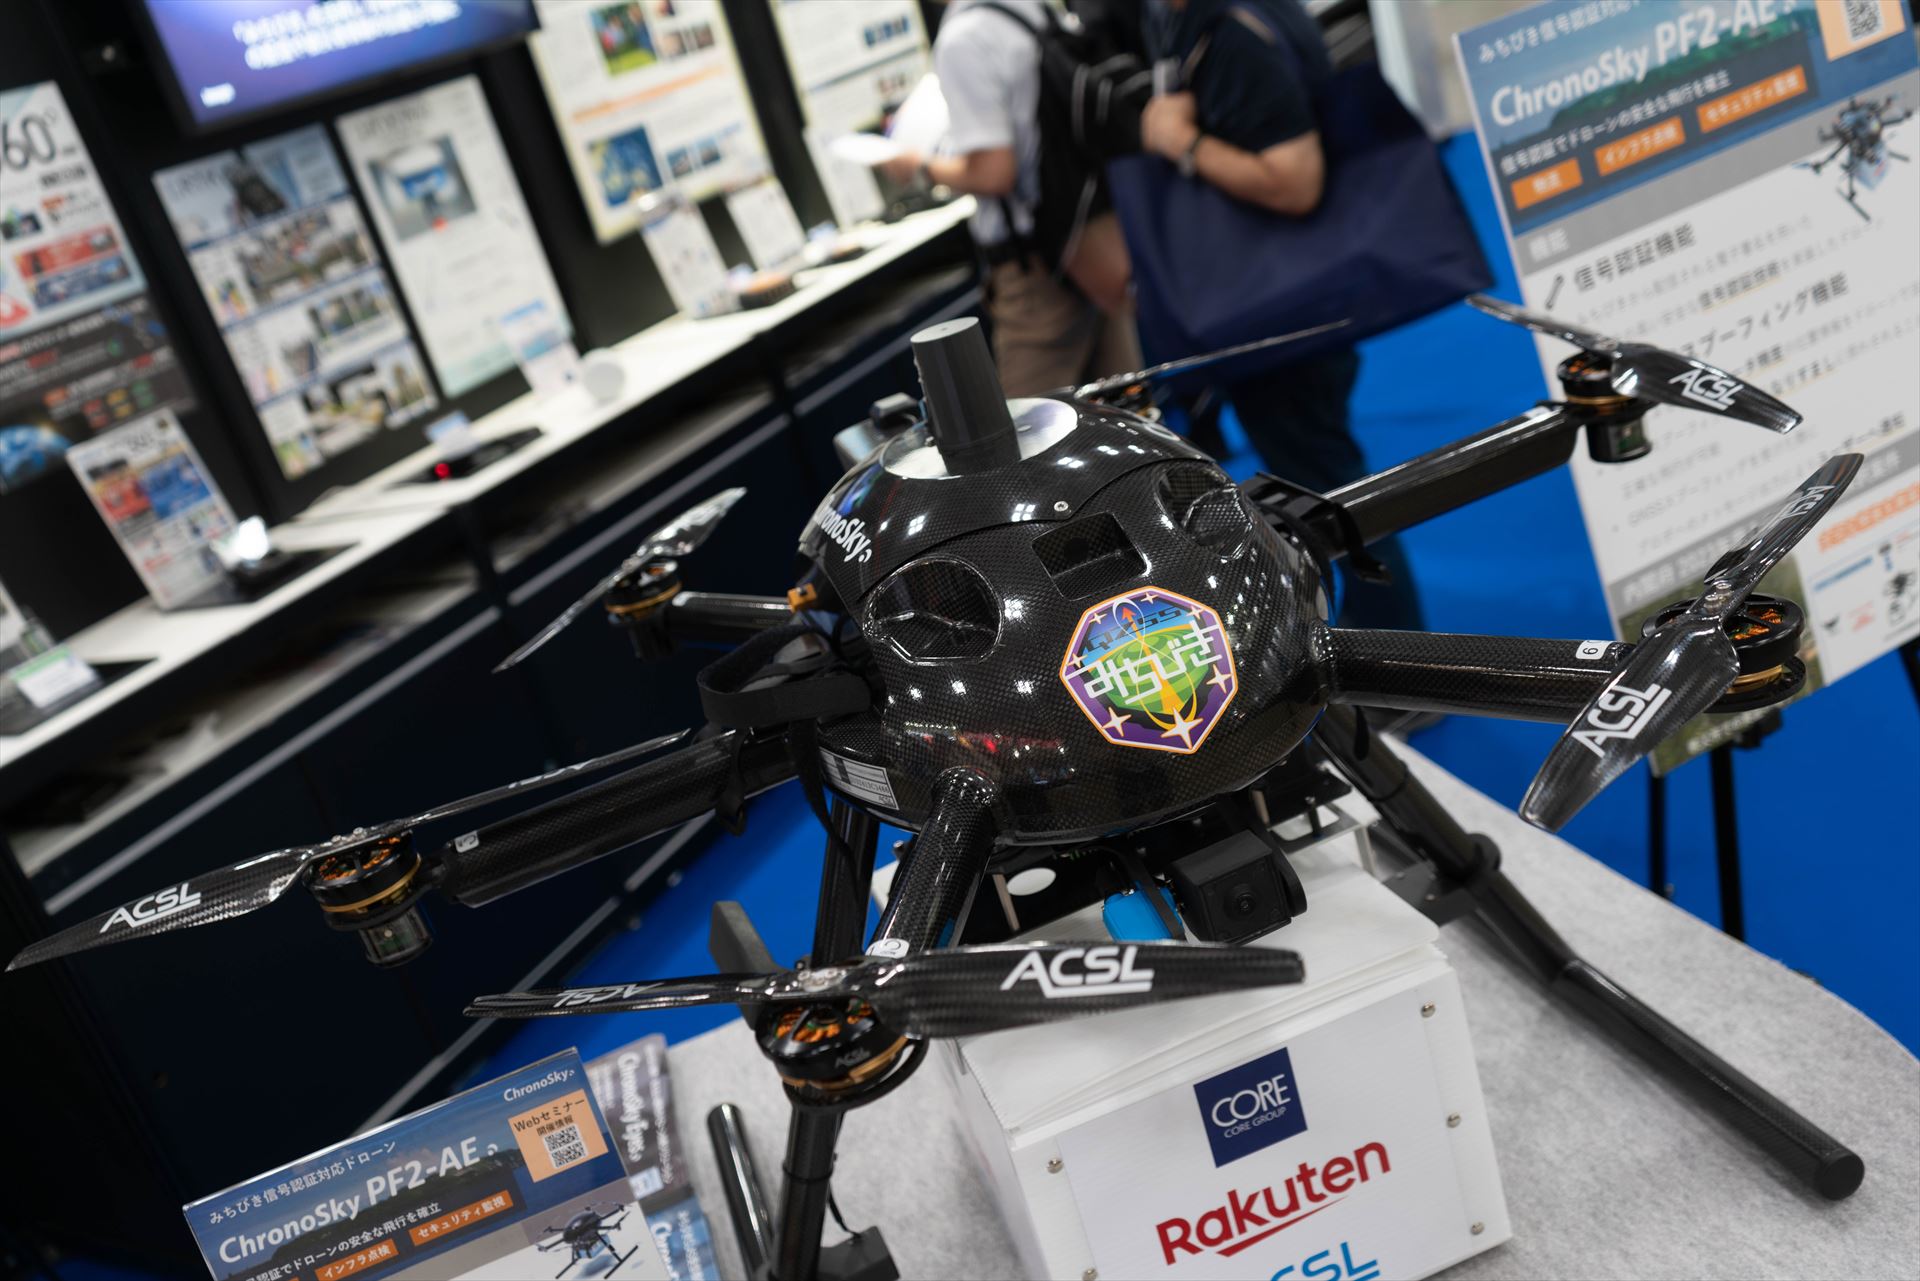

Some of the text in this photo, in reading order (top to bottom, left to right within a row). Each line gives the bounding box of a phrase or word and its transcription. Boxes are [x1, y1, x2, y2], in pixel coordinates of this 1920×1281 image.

[1491, 0, 1777, 126] ChronoSky PF2-AE
[1668, 367, 1744, 411] ACSL
[812, 493, 871, 562] onoSky
[1065, 619, 1222, 705] みちびき
[1571, 683, 1672, 758] ACSL
[100, 882, 201, 934] ACSL
[553, 982, 664, 1008] ACSL
[1000, 945, 1155, 998] ACSL
[503, 1069, 569, 1102] ChronoSky
[1212, 1074, 1291, 1128] CORE
[514, 1098, 585, 1133] Webセミナー
[1224, 1107, 1288, 1139] CORE GROUP
[209, 1141, 396, 1225] みちびき信号認証対応ドローン
[219, 1136, 480, 1263] ChronoSky PF2-AE
[1156, 1142, 1391, 1266] Rakuten
[245, 1202, 442, 1281] 認証でドローンの安全な飛行を確立
[417, 1195, 506, 1240] セキュリティ監視
[324, 1244, 392, 1280] インフラ点検
